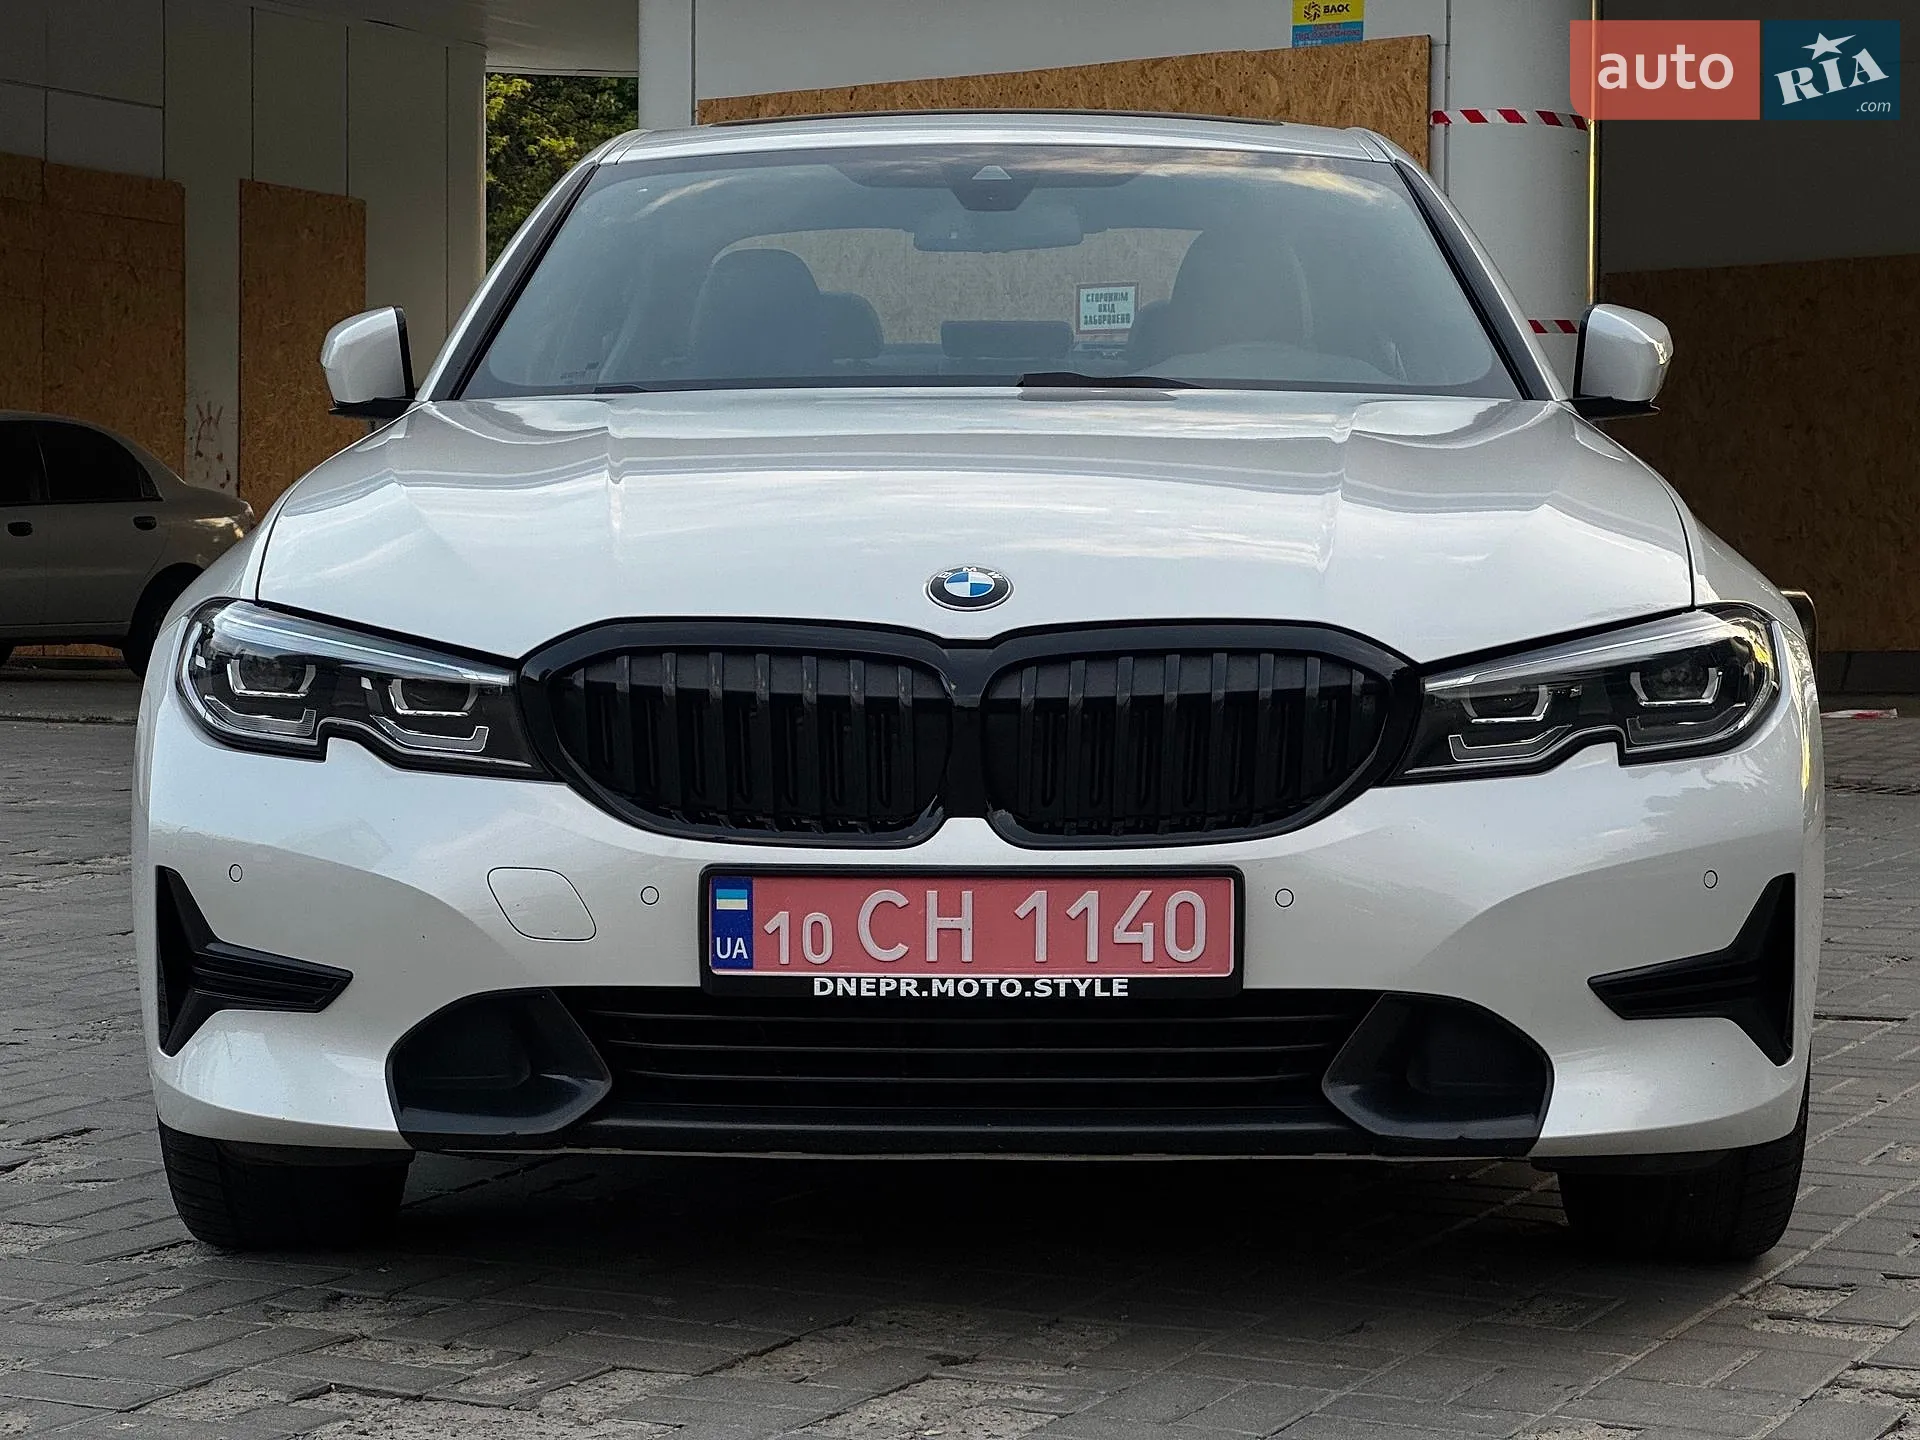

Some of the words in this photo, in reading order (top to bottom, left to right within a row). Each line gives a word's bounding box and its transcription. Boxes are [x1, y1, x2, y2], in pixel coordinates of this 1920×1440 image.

[938, 567, 1004, 579] BMW
[763, 911, 834, 965] 10
[857, 889, 973, 963] CH
[1013, 890, 1207, 963] 1140
[716, 936, 749, 959] UA
[813, 977, 1130, 998] DNEPR.MOTO.STYLE
